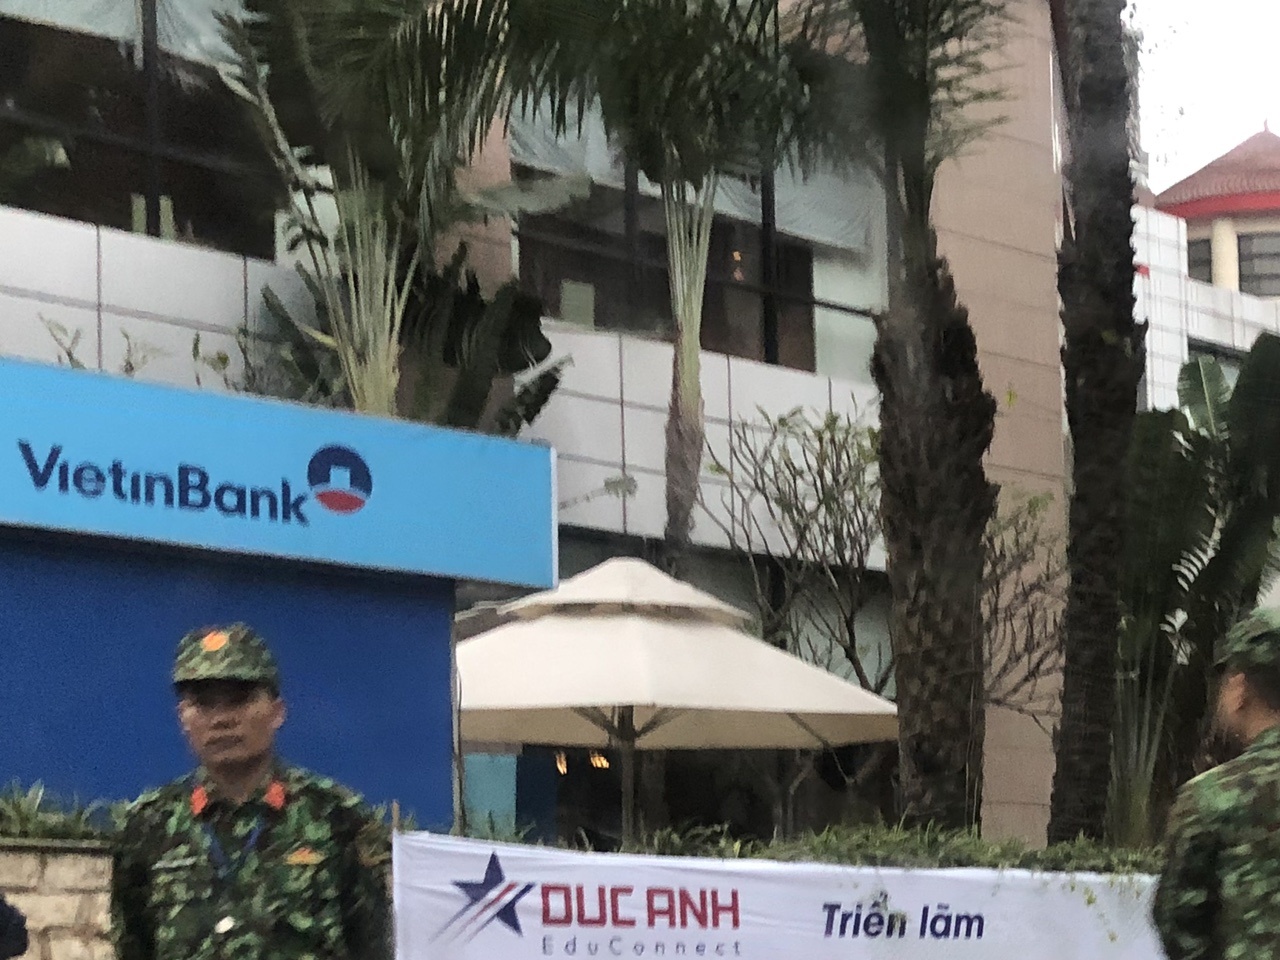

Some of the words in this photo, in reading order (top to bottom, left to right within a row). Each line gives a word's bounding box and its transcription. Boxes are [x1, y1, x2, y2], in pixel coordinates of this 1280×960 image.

[17, 438, 309, 527] VietinBank
[541, 884, 636, 928] DUC
[647, 886, 740, 930] ANH
[919, 903, 985, 939] lãm
[541, 934, 741, 956] EduConnect
